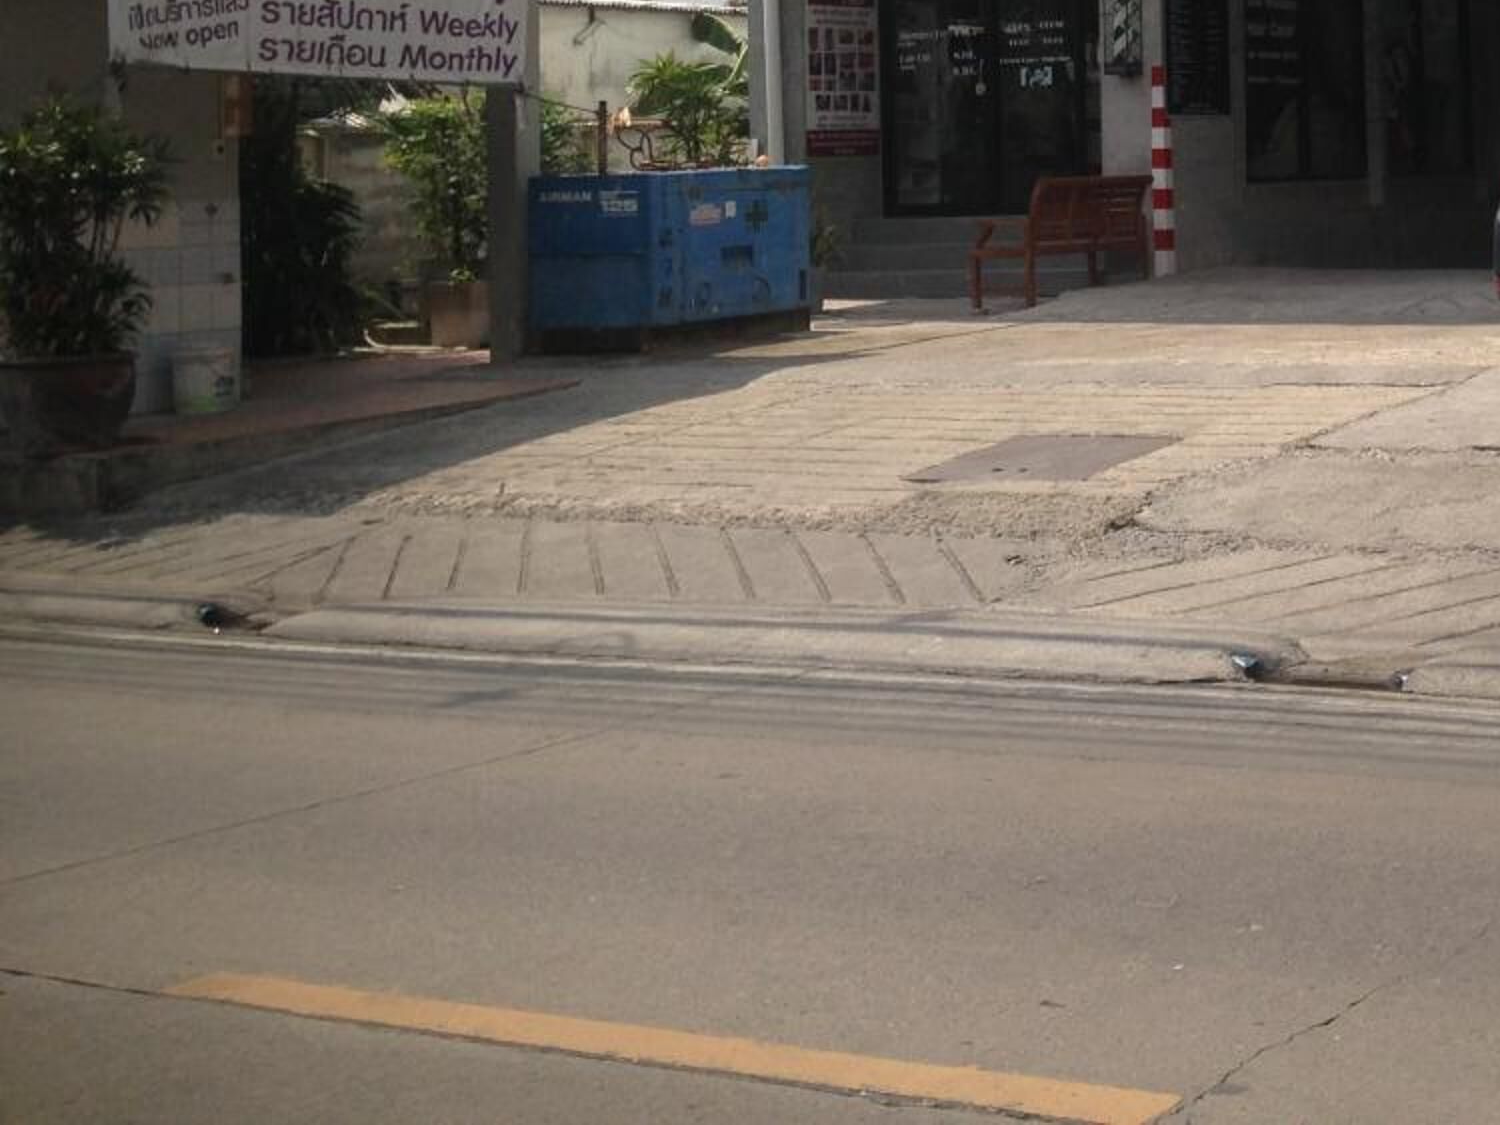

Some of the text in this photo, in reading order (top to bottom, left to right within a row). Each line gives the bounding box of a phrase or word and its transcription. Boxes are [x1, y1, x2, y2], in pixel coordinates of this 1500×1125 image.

[185, 19, 240, 49] open
[419, 8, 519, 42] Weekly
[398, 41, 519, 75] Monthly
